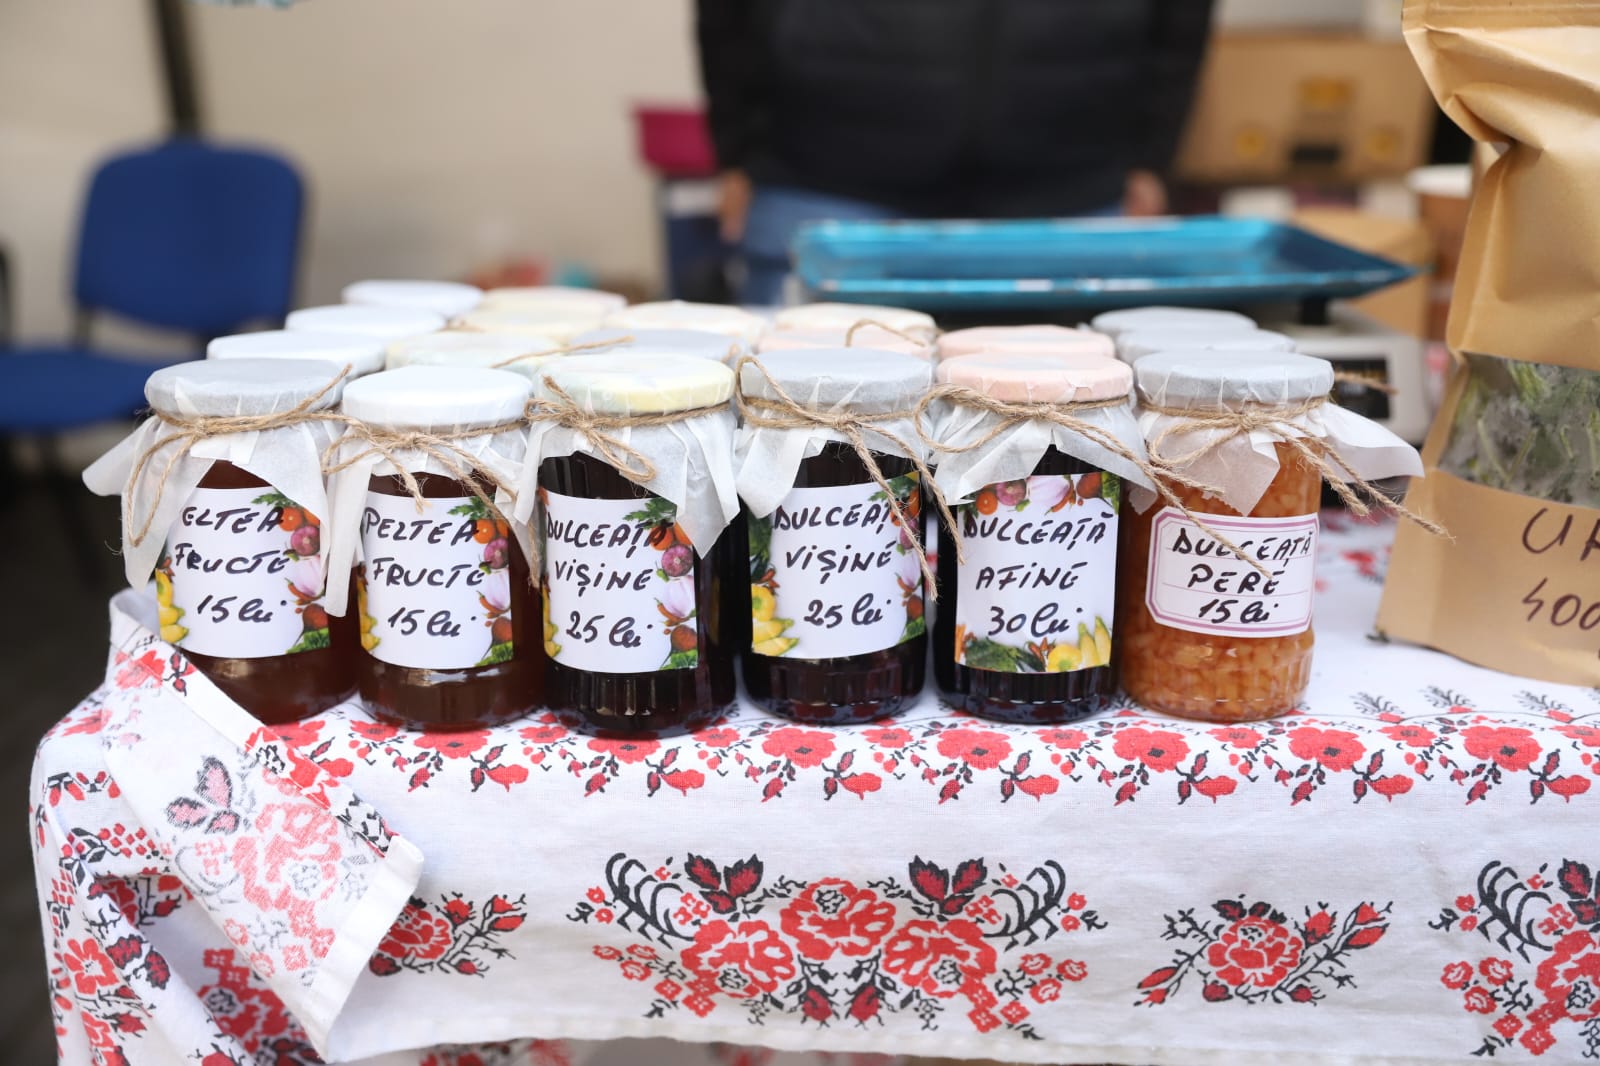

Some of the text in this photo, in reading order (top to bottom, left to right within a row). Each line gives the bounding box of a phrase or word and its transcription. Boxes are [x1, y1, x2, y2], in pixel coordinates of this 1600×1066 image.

[181, 506, 285, 534] ELTEA
[175, 542, 291, 575] FRUCTE
[372, 556, 486, 589] FRUCTE
[975, 562, 1089, 591] AFINE
[1187, 563, 1286, 596] PERE
